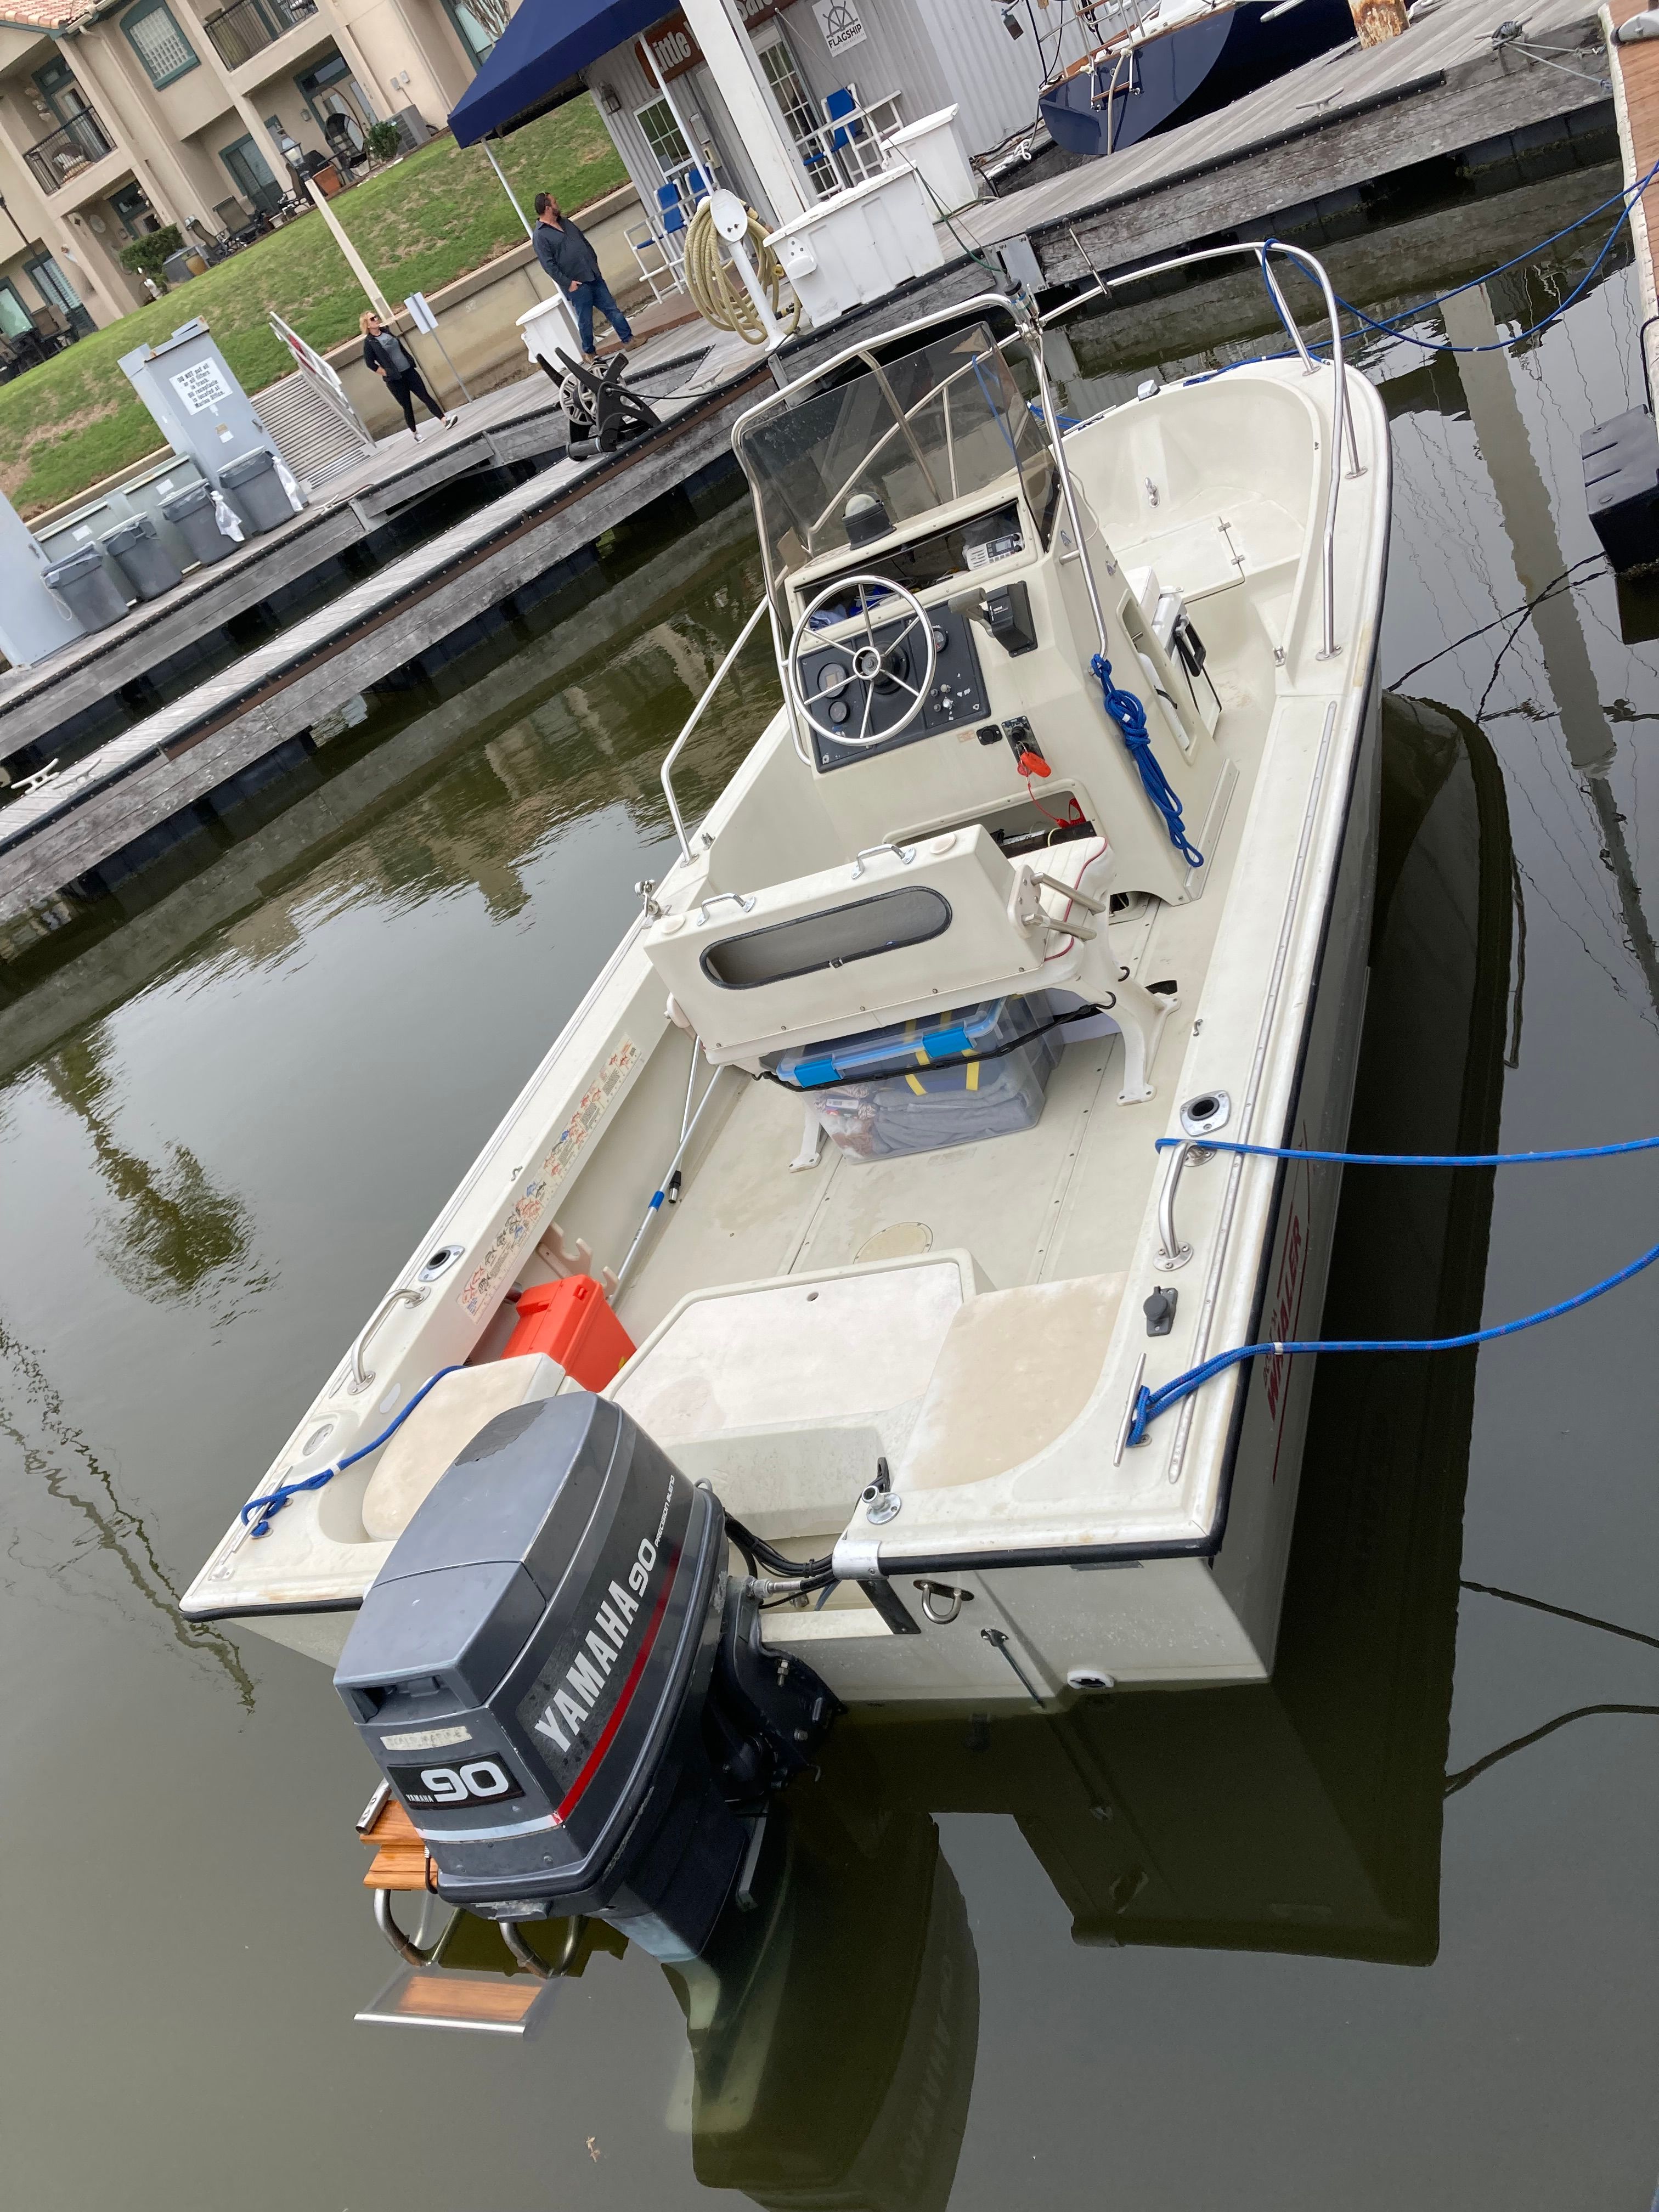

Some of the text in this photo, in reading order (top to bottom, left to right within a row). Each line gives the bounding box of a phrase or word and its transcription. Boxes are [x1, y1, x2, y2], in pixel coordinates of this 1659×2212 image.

[652, 31, 691, 74] ittle
[828, 24, 862, 49] FLAGSHIP
[534, 1474, 675, 1753] YAMAHA 90 PRECISION BLEND
[405, 1761, 509, 1803] YAMAHA 90
